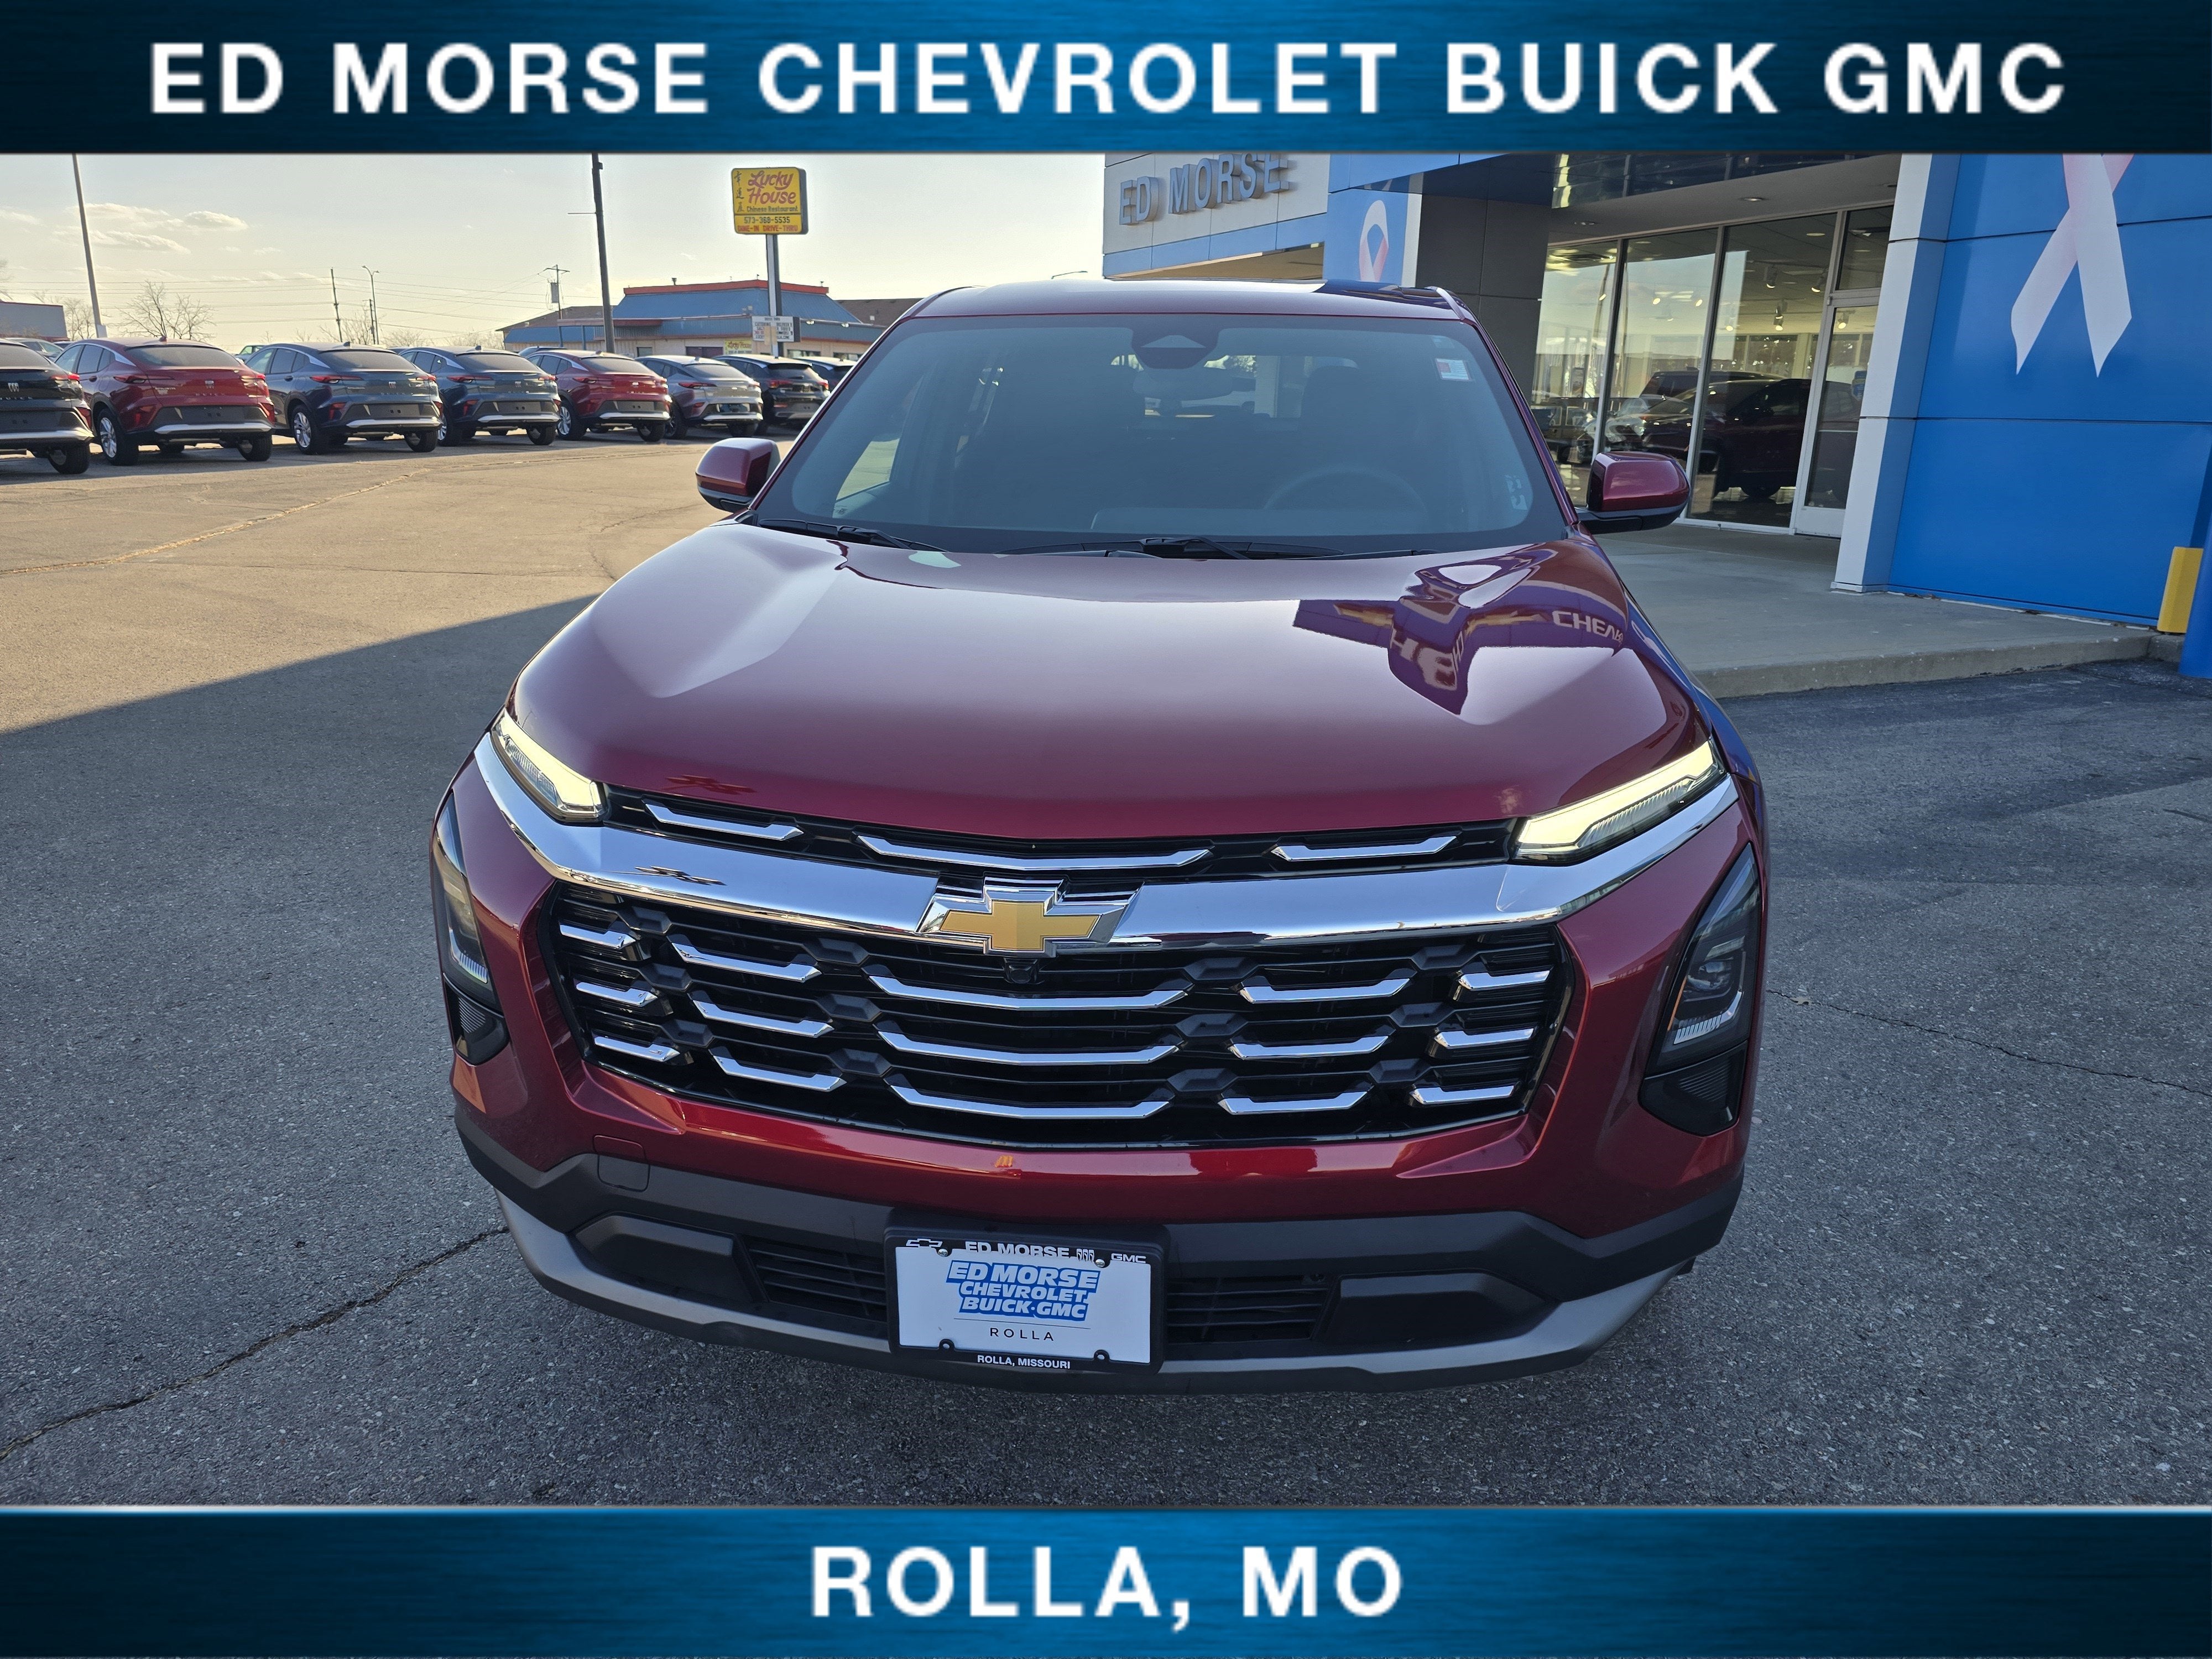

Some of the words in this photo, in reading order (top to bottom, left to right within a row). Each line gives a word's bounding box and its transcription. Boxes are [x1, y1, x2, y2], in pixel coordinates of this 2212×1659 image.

[748, 170, 794, 190] Lucky
[1119, 175, 1159, 225] ED
[1168, 153, 1289, 214] MORSE
[747, 187, 796, 205] House
[964, 1241, 992, 1253] ED
[997, 1243, 1070, 1258] MORSE
[1111, 1253, 1146, 1264] GMC
[948, 1261, 988, 1280] ED
[990, 1264, 1099, 1289] MORSE
[960, 1280, 1087, 1302] CHEVROLET
[990, 1327, 1054, 1341] ROLLA
[977, 1354, 1015, 1367] ROLLA,
[1018, 1357, 1071, 1369] MISSOURI
